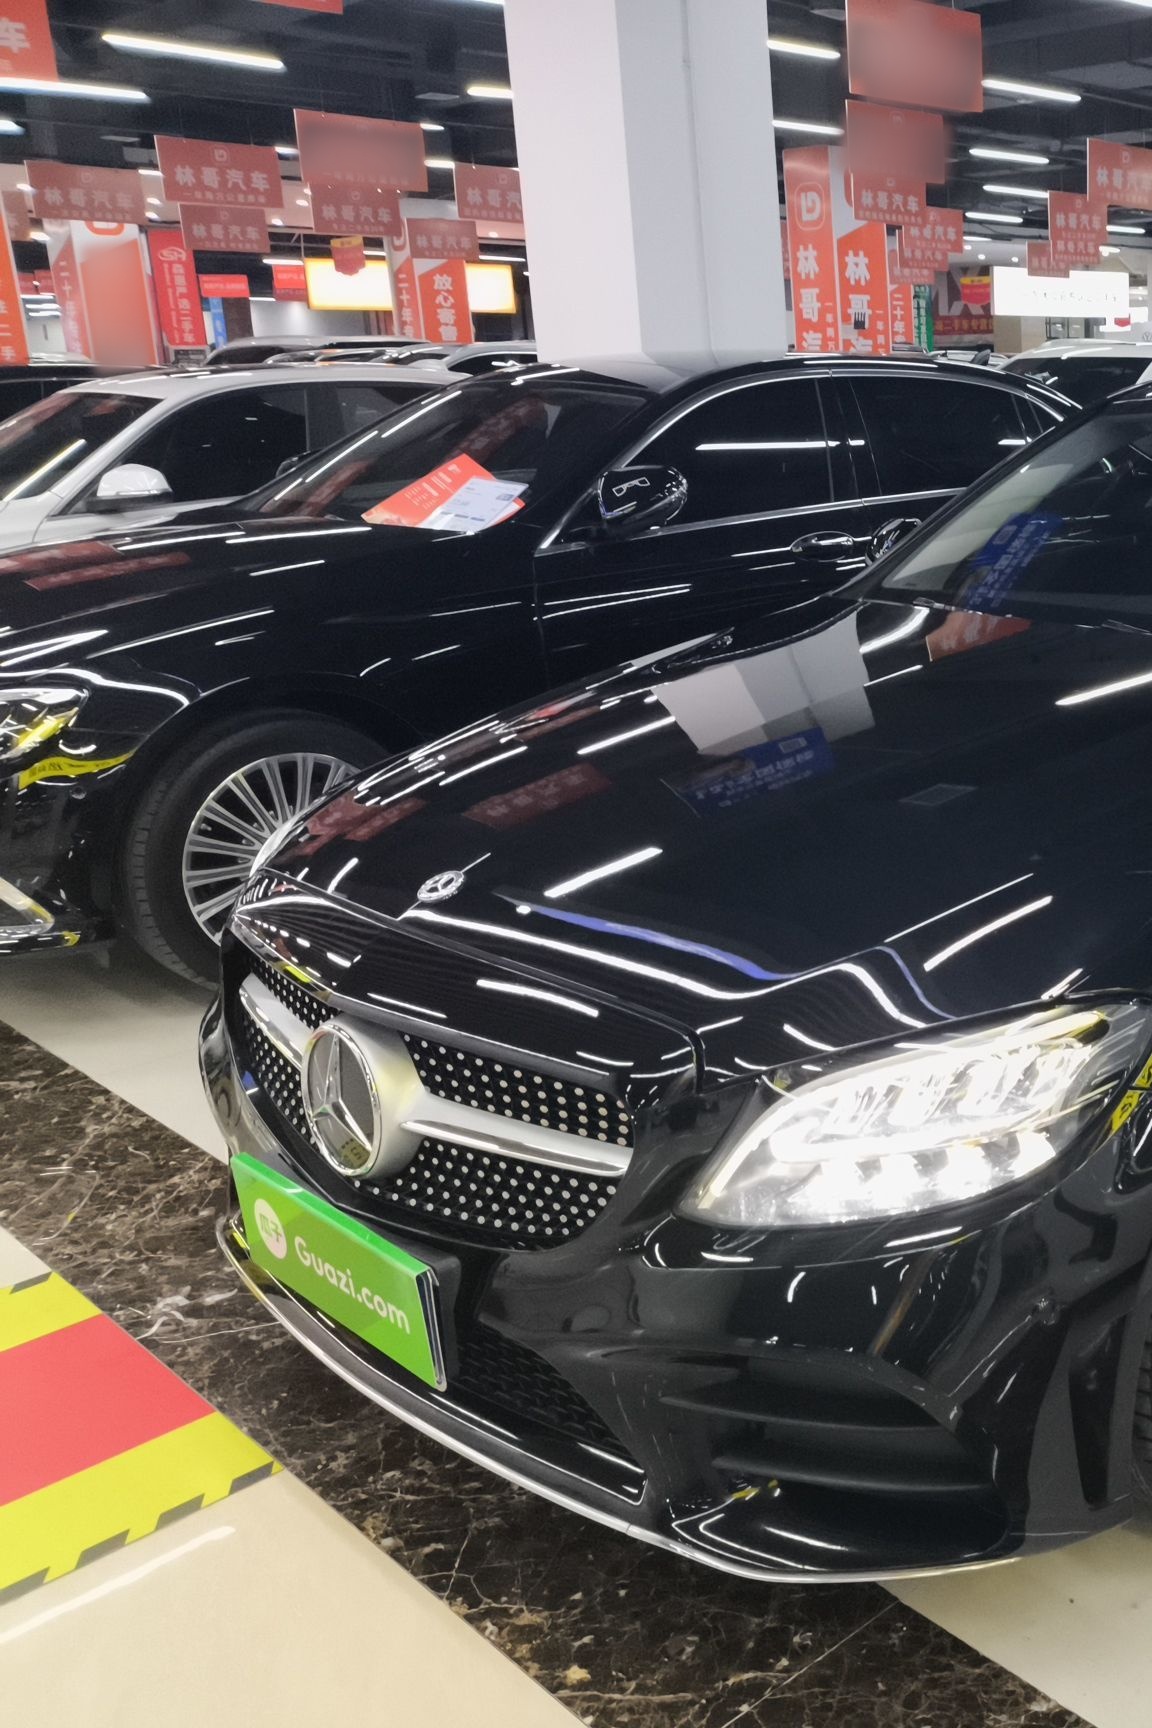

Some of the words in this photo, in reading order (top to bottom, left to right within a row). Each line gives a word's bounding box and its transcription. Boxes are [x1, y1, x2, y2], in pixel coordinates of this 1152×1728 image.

[174, 165, 270, 192] 林哥汽车
[44, 186, 136, 209] 林哥汽车
[861, 189, 919, 213] 林哥汽车
[322, 204, 392, 224] 林哥汽车
[1056, 212, 1102, 231] 林哥汽车
[192, 223, 260, 242] 林哥汽车
[416, 234, 473, 250] 林哥汽车
[910, 225, 957, 241] 林哥汽车
[1057, 241, 1096, 254] 林哥汽车
[294, 1236, 411, 1335] Guazi.com
